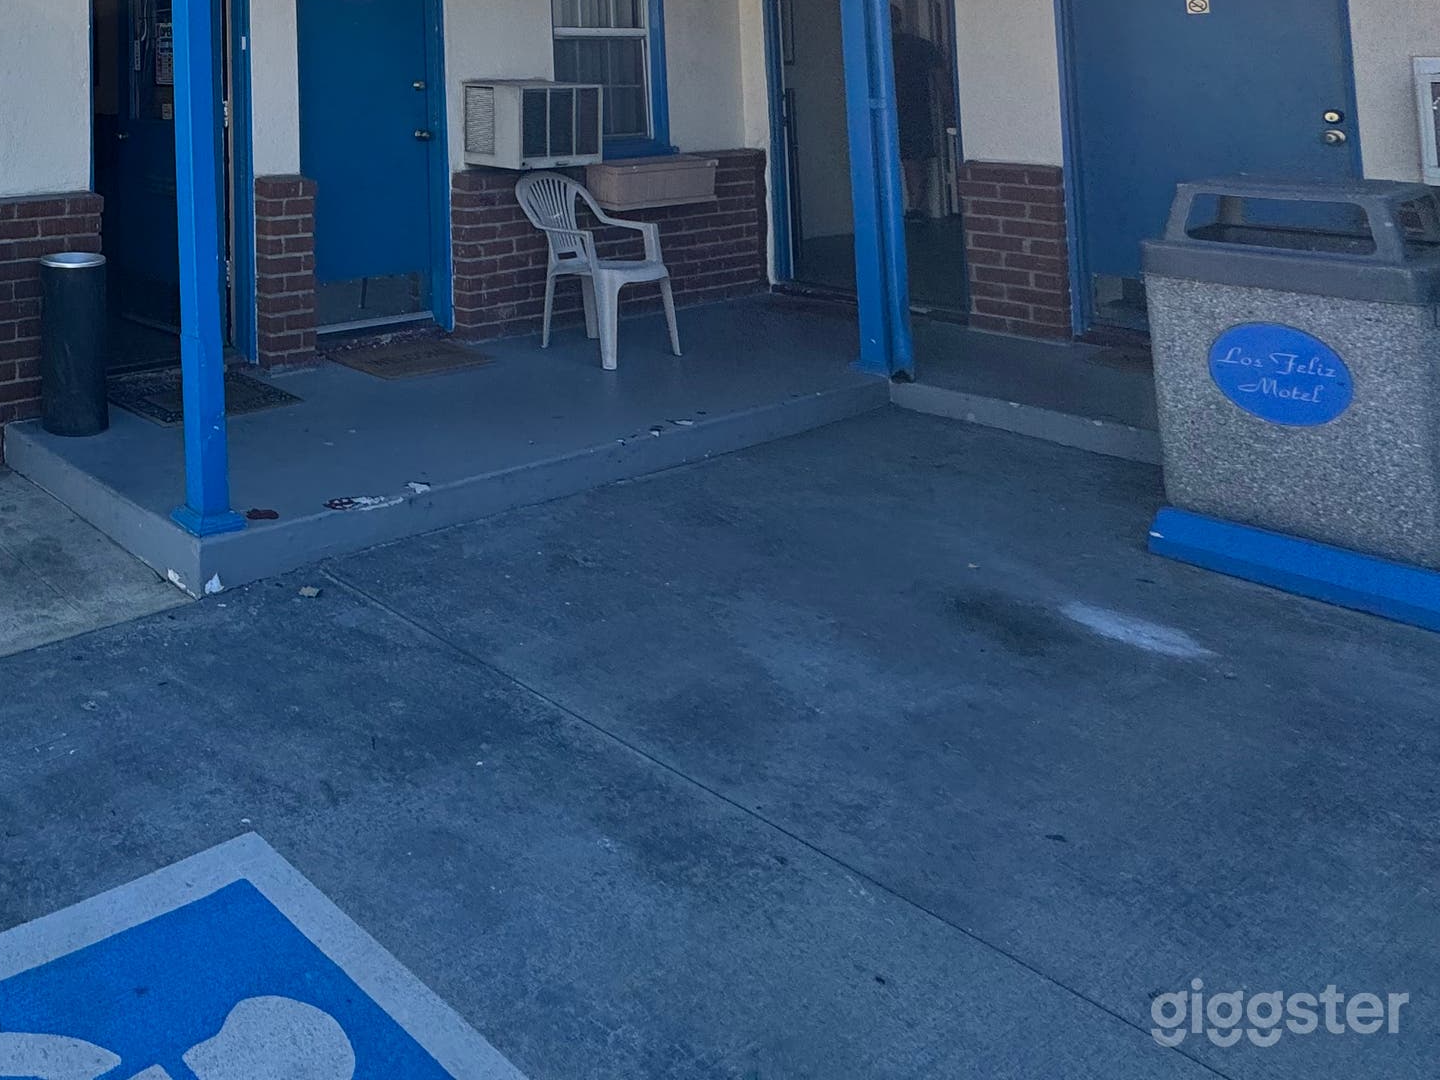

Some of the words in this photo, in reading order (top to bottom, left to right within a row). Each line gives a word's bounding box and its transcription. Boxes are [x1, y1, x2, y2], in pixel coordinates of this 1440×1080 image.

[1216, 347, 1263, 369] Los
[1268, 351, 1337, 378] Feliz
[1237, 377, 1324, 404] Motel
